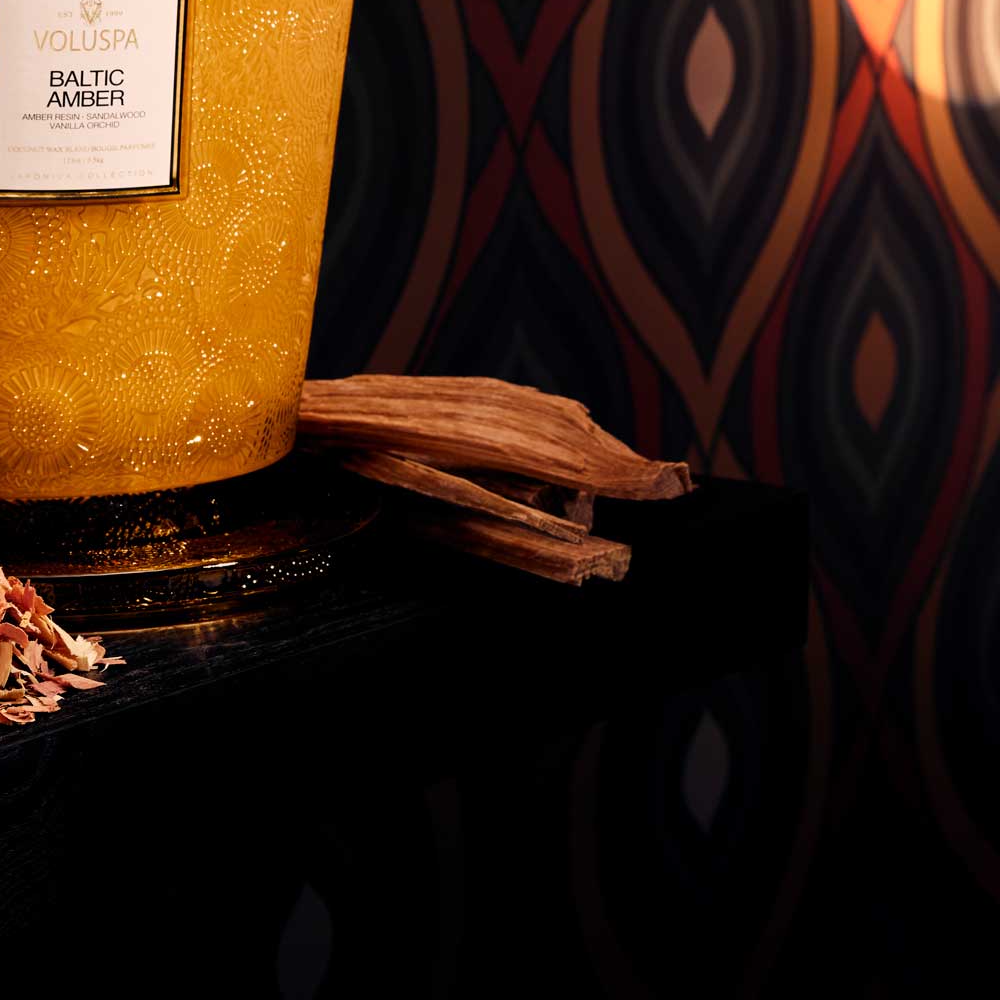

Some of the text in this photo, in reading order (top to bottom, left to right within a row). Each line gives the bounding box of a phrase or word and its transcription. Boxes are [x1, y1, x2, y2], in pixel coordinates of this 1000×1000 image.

[33, 28, 139, 51] VOLUSPA
[49, 68, 125, 87] BALTIC
[46, 90, 125, 108] AMBER
[22, 111, 146, 121] AMBER RESIN SANDALWOOD
[49, 121, 120, 130] VANILLA ORCHID
